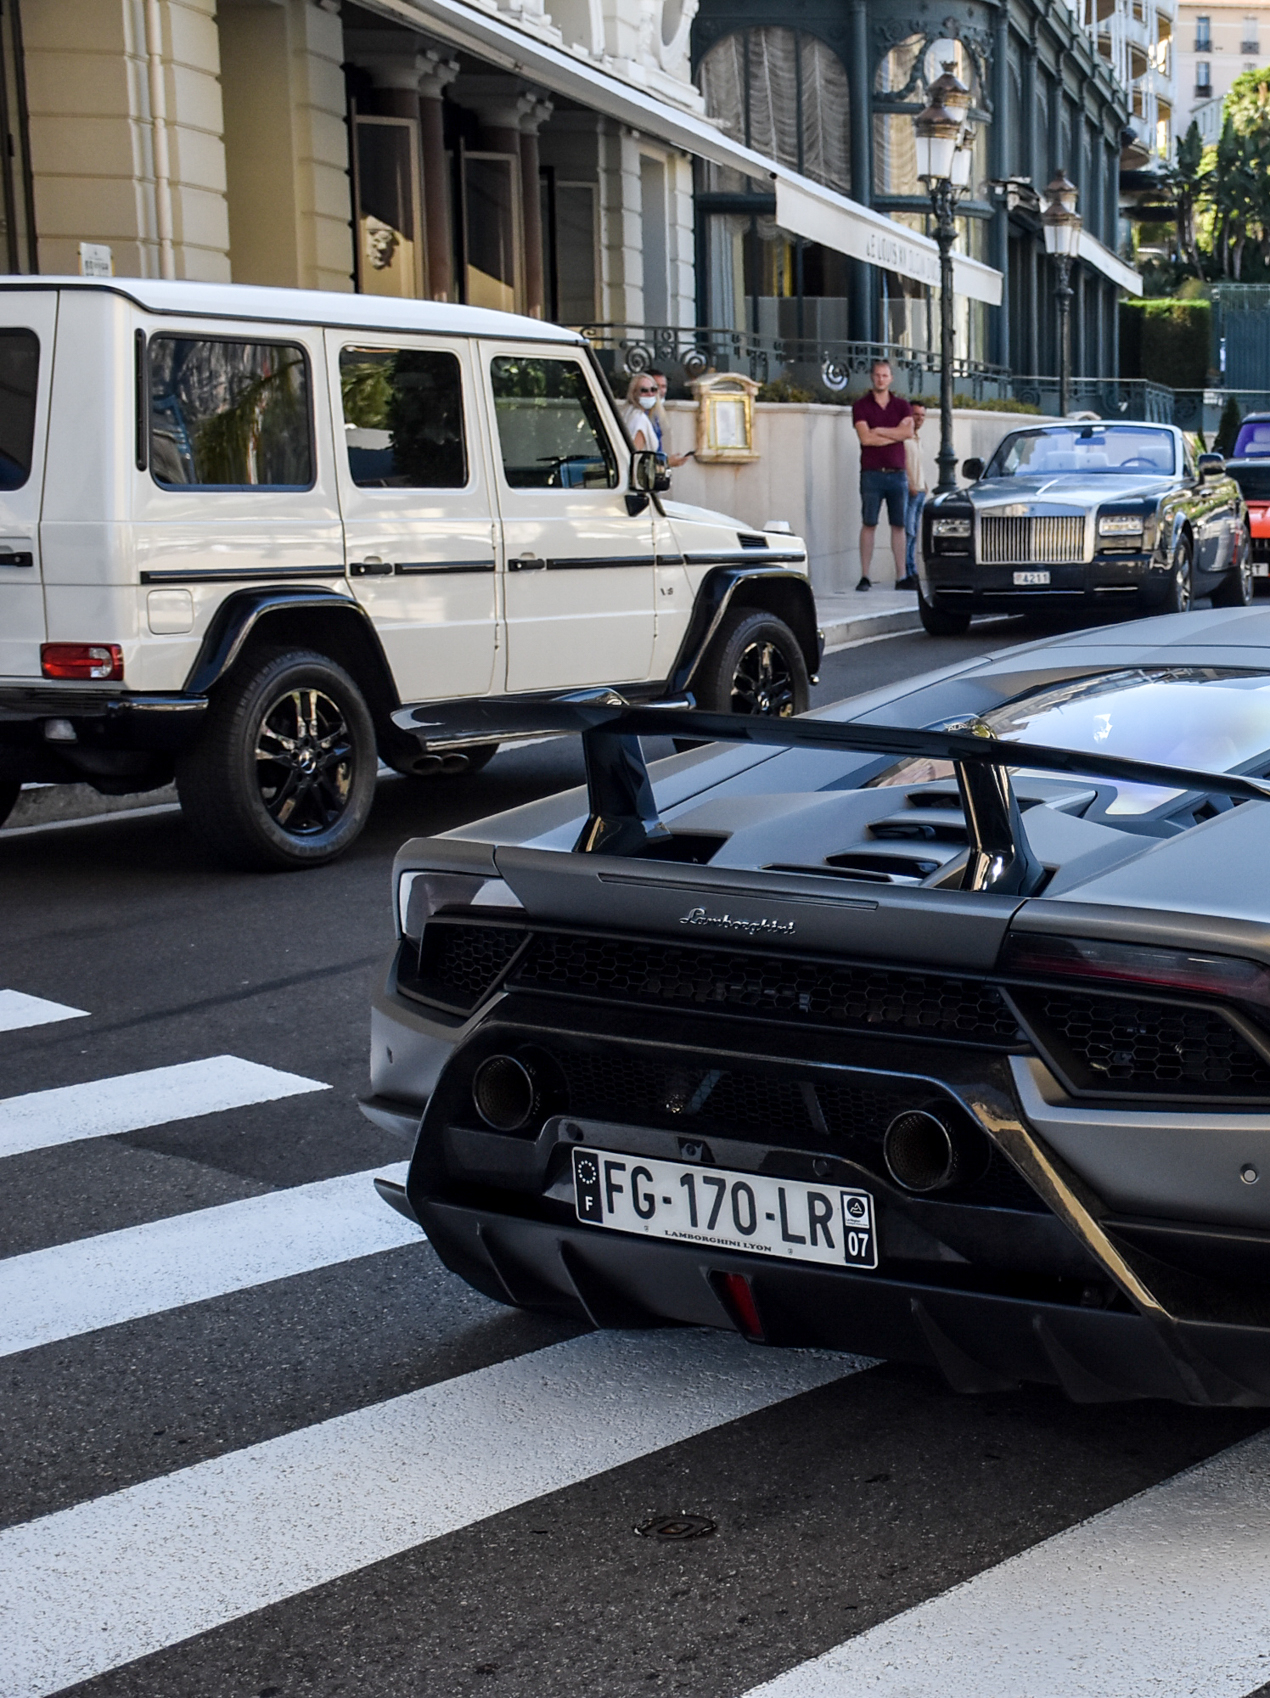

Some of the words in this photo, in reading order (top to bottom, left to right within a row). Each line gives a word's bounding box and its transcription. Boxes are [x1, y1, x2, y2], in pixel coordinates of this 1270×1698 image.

[680, 907, 796, 935] Lamborghini
[585, 1195, 594, 1212] F
[604, 1160, 835, 1249] FG-170-LR
[664, 1229, 741, 1249] LAMBORGHINI
[743, 1241, 772, 1253] LYON
[848, 1231, 869, 1258] 07
